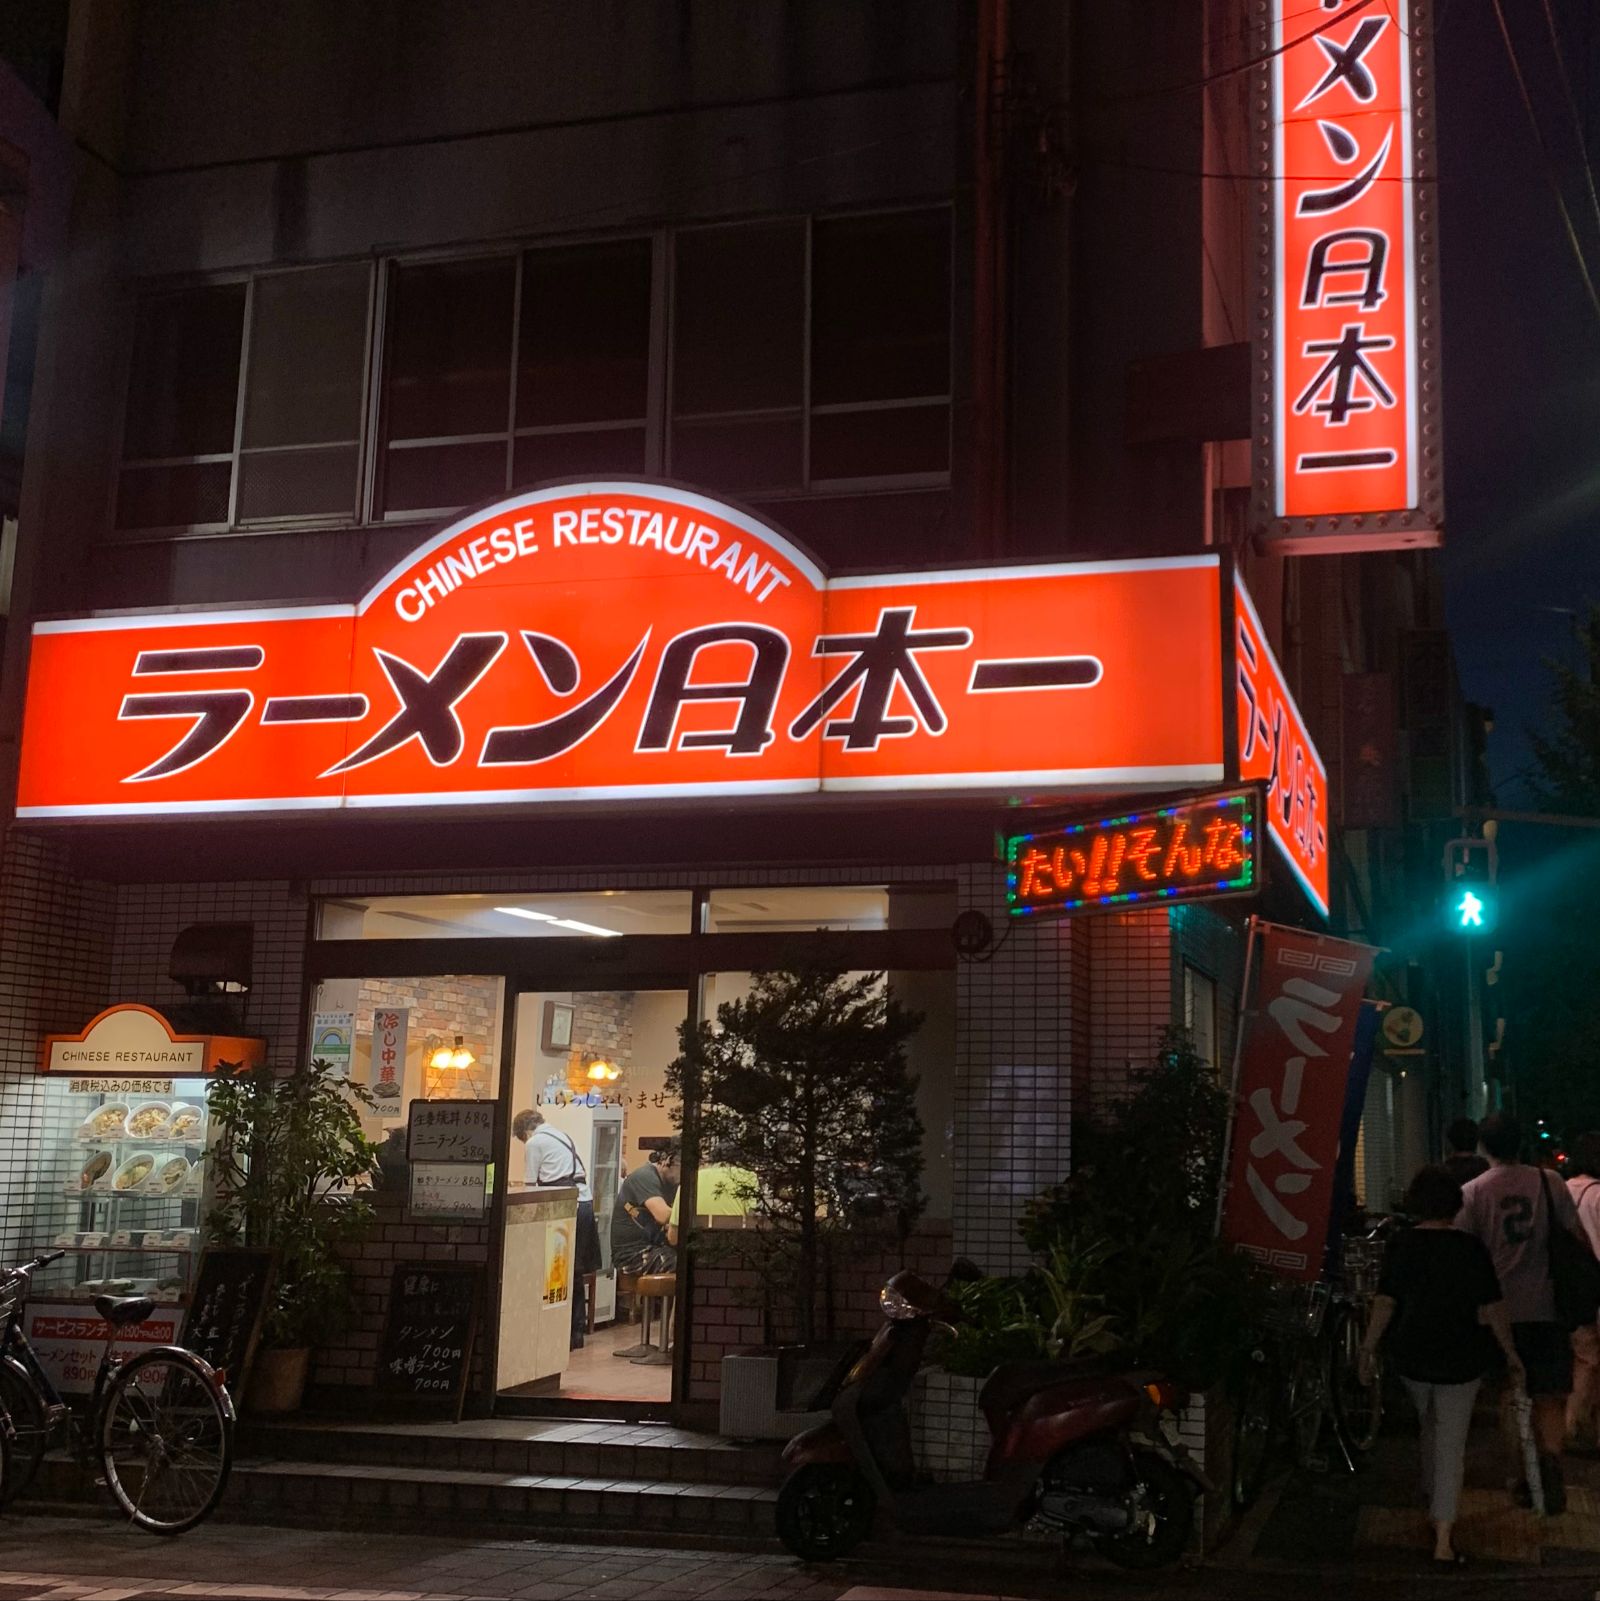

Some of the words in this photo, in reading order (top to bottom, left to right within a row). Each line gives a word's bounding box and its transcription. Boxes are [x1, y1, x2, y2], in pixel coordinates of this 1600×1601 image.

[1293, 0, 1398, 475] メン日本一
[394, 518, 539, 622] CHINESE
[553, 507, 792, 603] RESTAURANT
[117, 605, 1104, 783] ラーメン日本一
[62, 1051, 110, 1062] CHINESE
[115, 1052, 193, 1063] RESTAURANT
[380, 1012, 400, 1084] 冷し中華
[69, 1079, 173, 1093] 消費税込みの価格です
[536, 1090, 667, 1108] いらっしゃいませ
[1247, 977, 1343, 1240] ラーメン
[35, 1320, 108, 1337] サービスランチ
